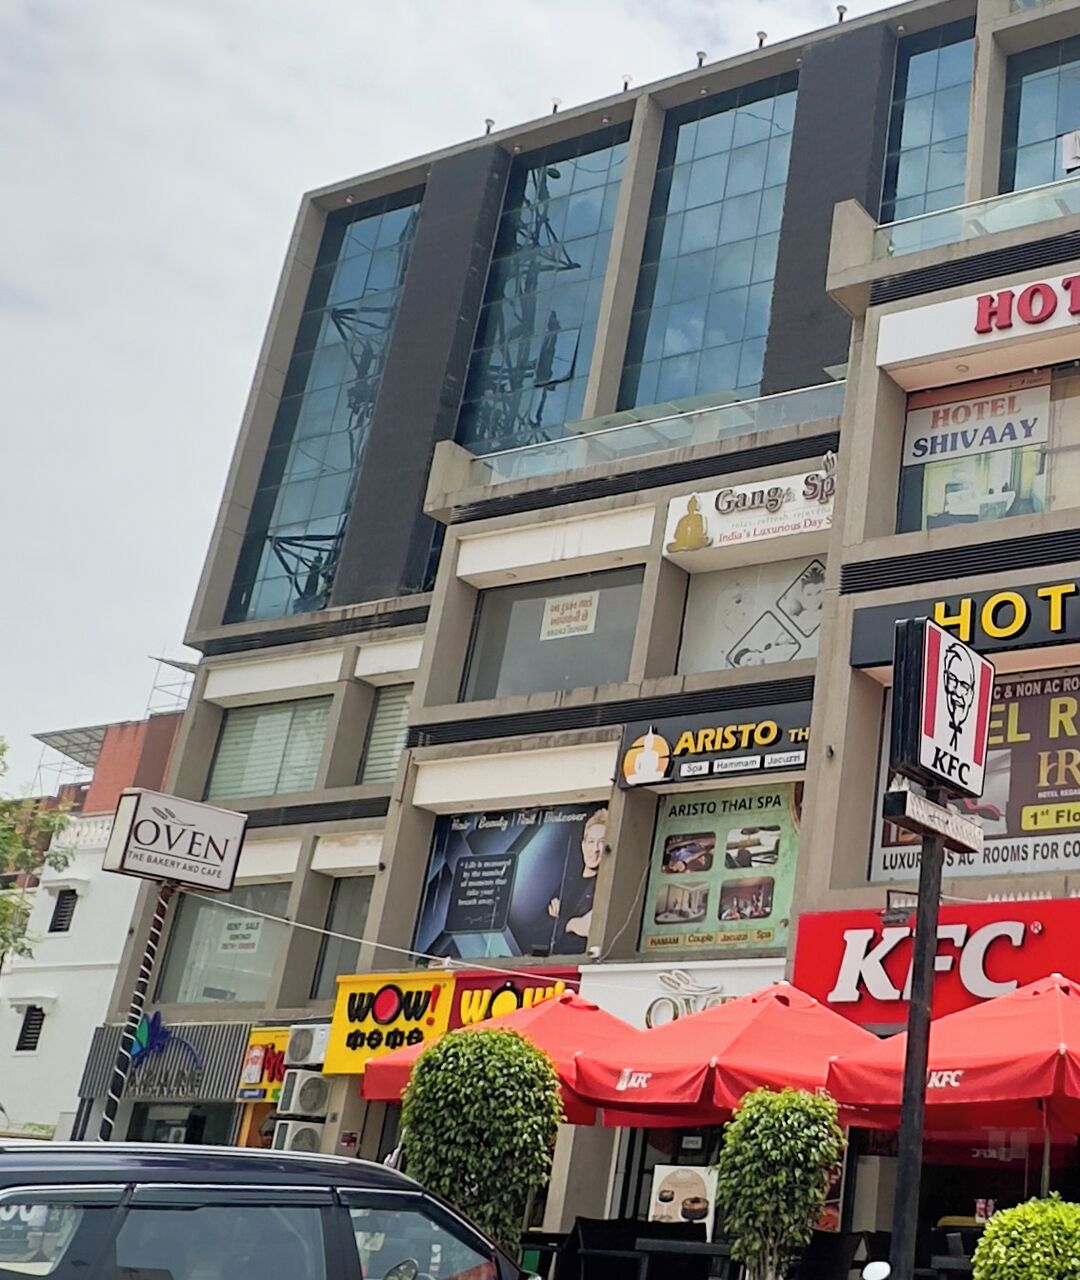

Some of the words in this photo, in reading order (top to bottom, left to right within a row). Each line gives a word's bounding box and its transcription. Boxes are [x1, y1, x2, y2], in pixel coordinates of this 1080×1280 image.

[930, 395, 1022, 430] HOTEL
[912, 417, 1038, 458] SHIVAAY
[719, 528, 751, 543] India's
[753, 523, 801, 537] Luxurious
[803, 517, 823, 531] Day
[1016, 682, 1041, 696] NON
[1044, 679, 1061, 694] AC
[674, 720, 778, 755] ARISTO
[687, 763, 703, 774] Spa
[716, 759, 757, 770] Hammam
[768, 753, 801, 766] Jacuzzi
[931, 746, 971, 786] KFC
[668, 801, 717, 818] ARISTO
[721, 797, 753, 812] THAI
[757, 794, 782, 809] SPA
[1038, 790, 1059, 799] HOTEL
[1030, 808, 1050, 826] 1st
[134, 819, 229, 862] OVEN
[983, 844, 1029, 863] ROOMS
[1033, 841, 1058, 860] FOR
[128, 850, 145, 862] THE
[147, 855, 181, 870] BAKERY
[182, 864, 199, 874] AND
[756, 930, 771, 940] Spa
[827, 920, 1026, 1003] KFC
[347, 984, 442, 1026] WOW!
[627, 1072, 652, 1089] KFC
[927, 1070, 965, 1088] KFC
